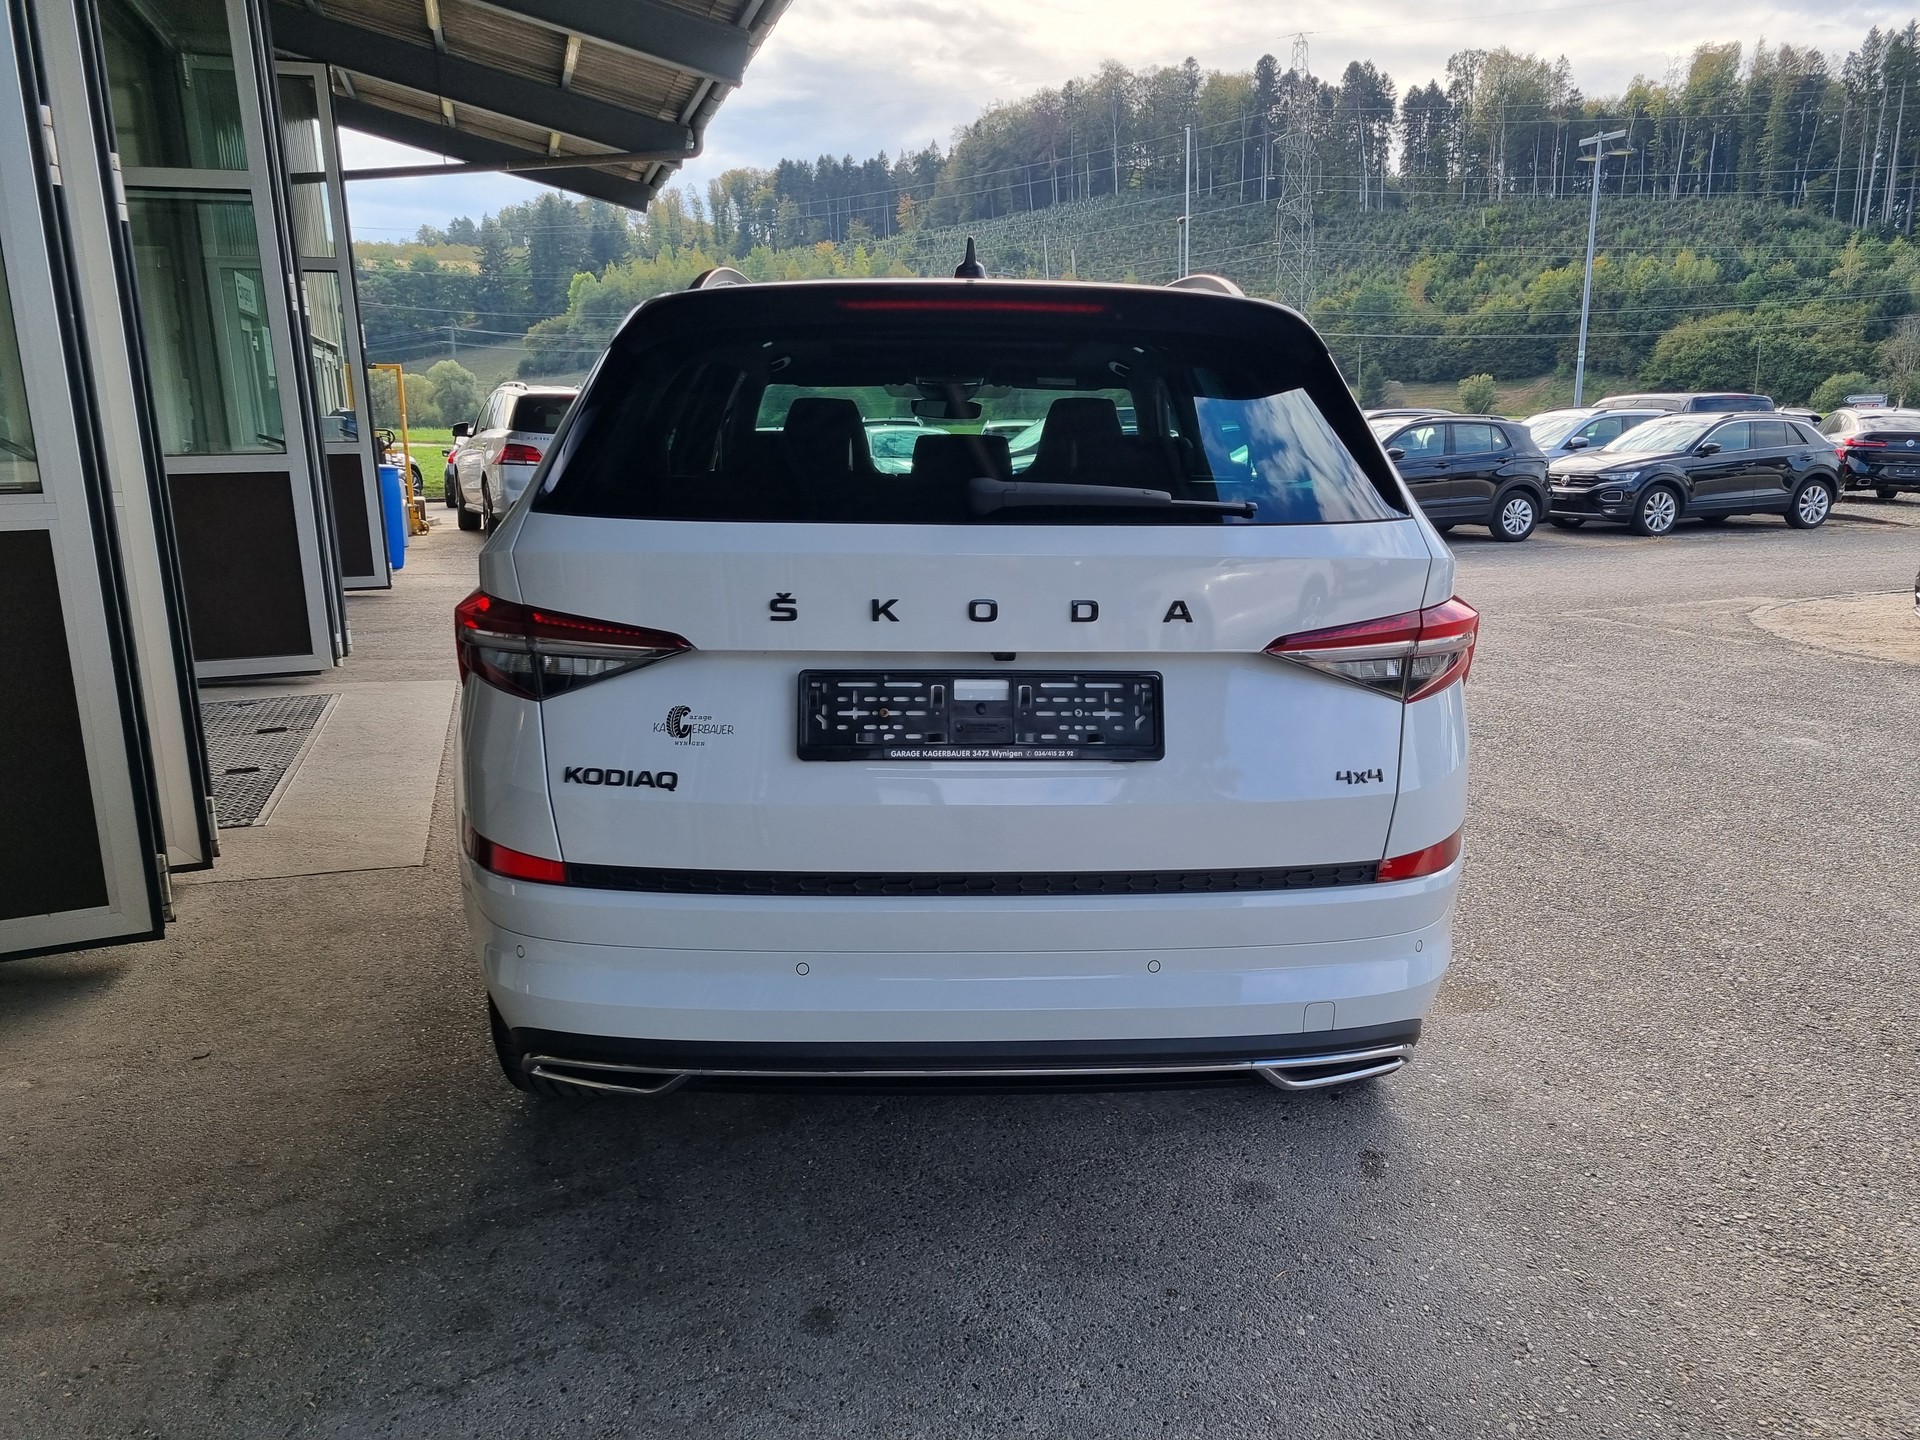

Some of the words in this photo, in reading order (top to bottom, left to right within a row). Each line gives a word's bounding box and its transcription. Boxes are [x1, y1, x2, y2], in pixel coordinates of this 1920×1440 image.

[770, 593, 1194, 623] ŠKODA
[991, 750, 1023, 758] Wynigen
[564, 766, 679, 791] KODIAQ
[1336, 768, 1384, 784] 4x4
